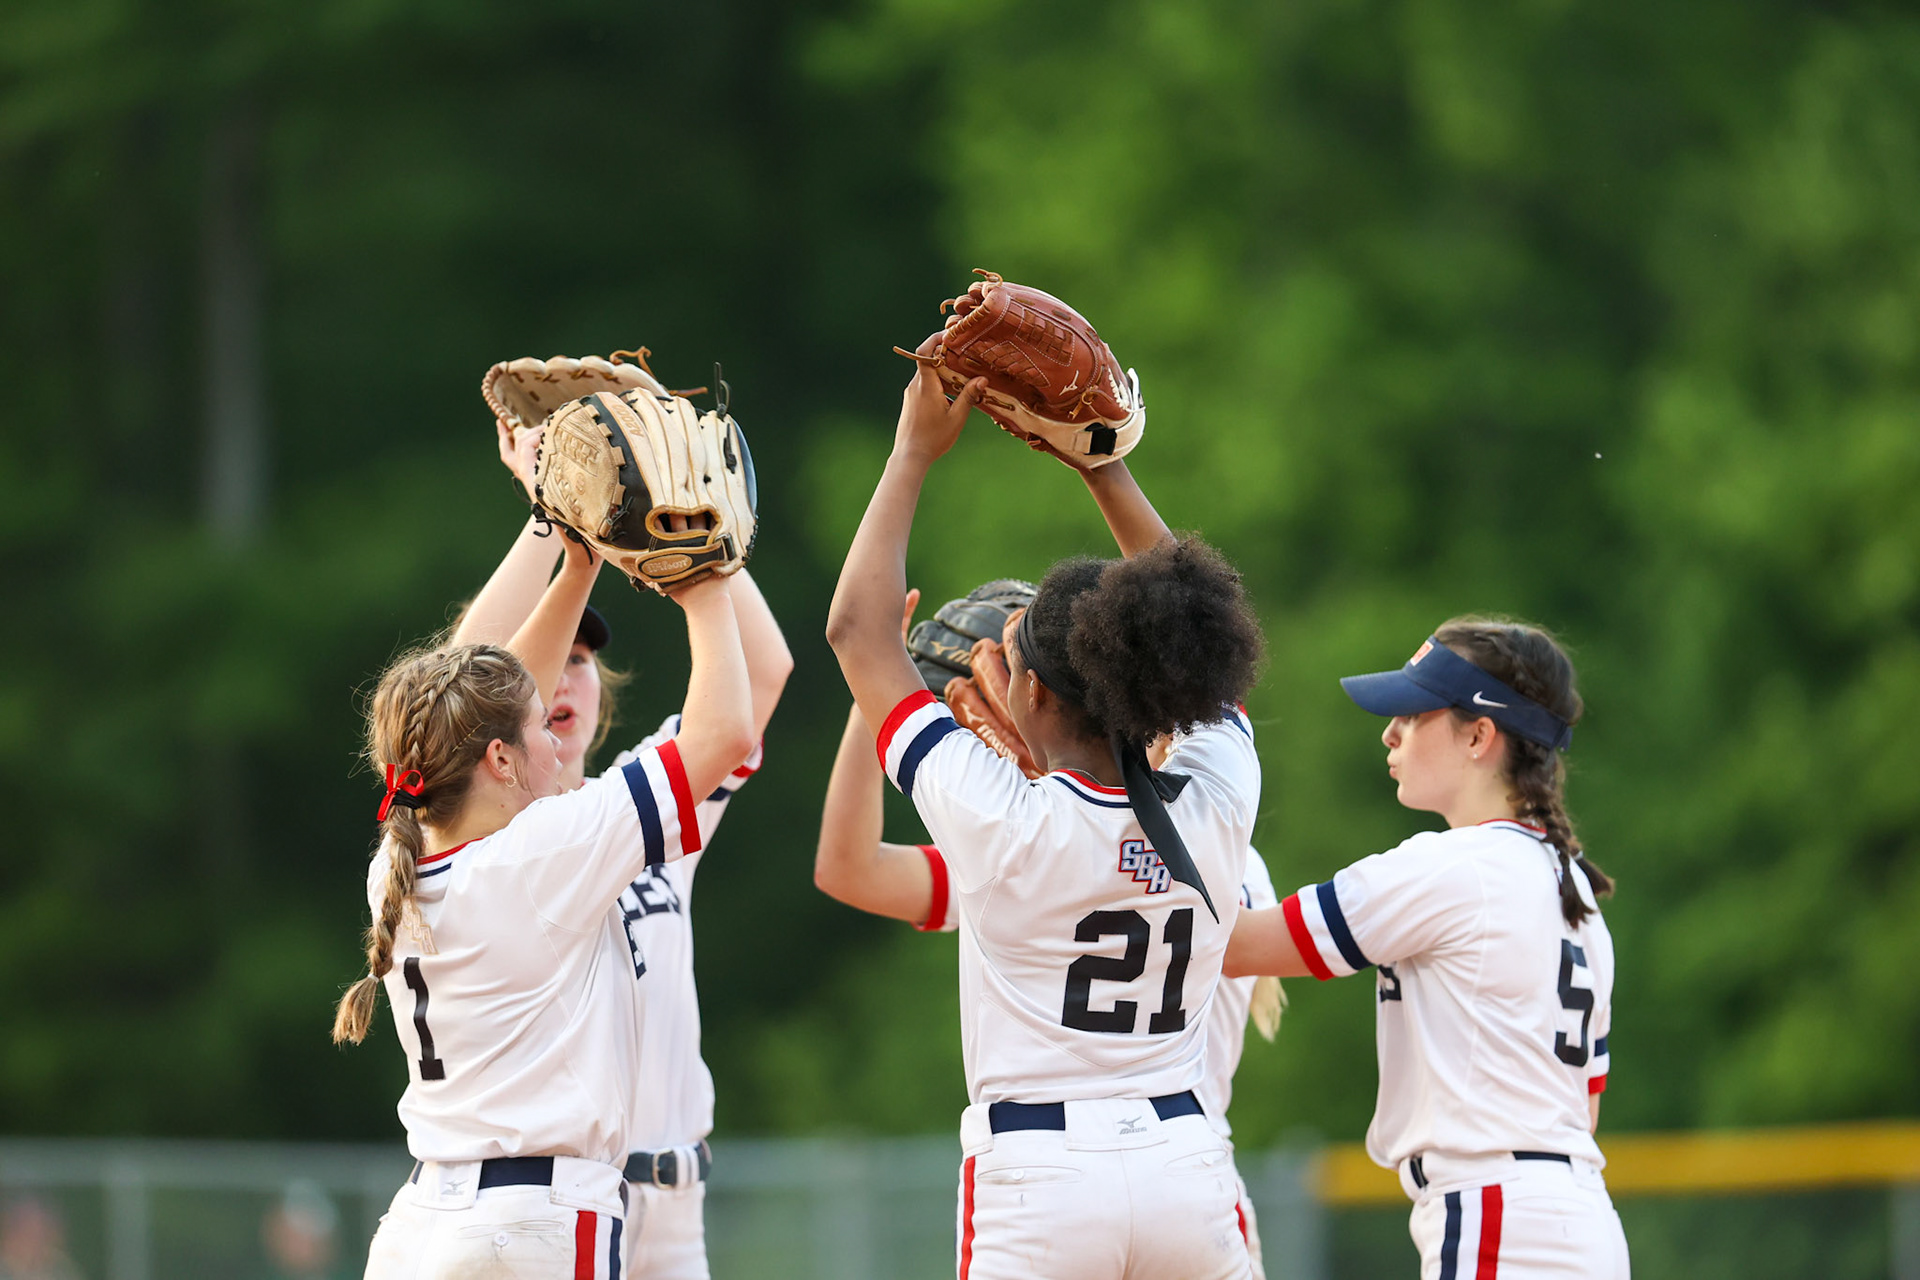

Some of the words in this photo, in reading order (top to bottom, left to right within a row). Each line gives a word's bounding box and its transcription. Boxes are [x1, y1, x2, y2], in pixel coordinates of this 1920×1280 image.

[1118, 839, 1173, 894] SBA
[403, 956, 446, 1081] 1
[1061, 908, 1194, 1034] 21
[1554, 938, 1595, 1067] 5
